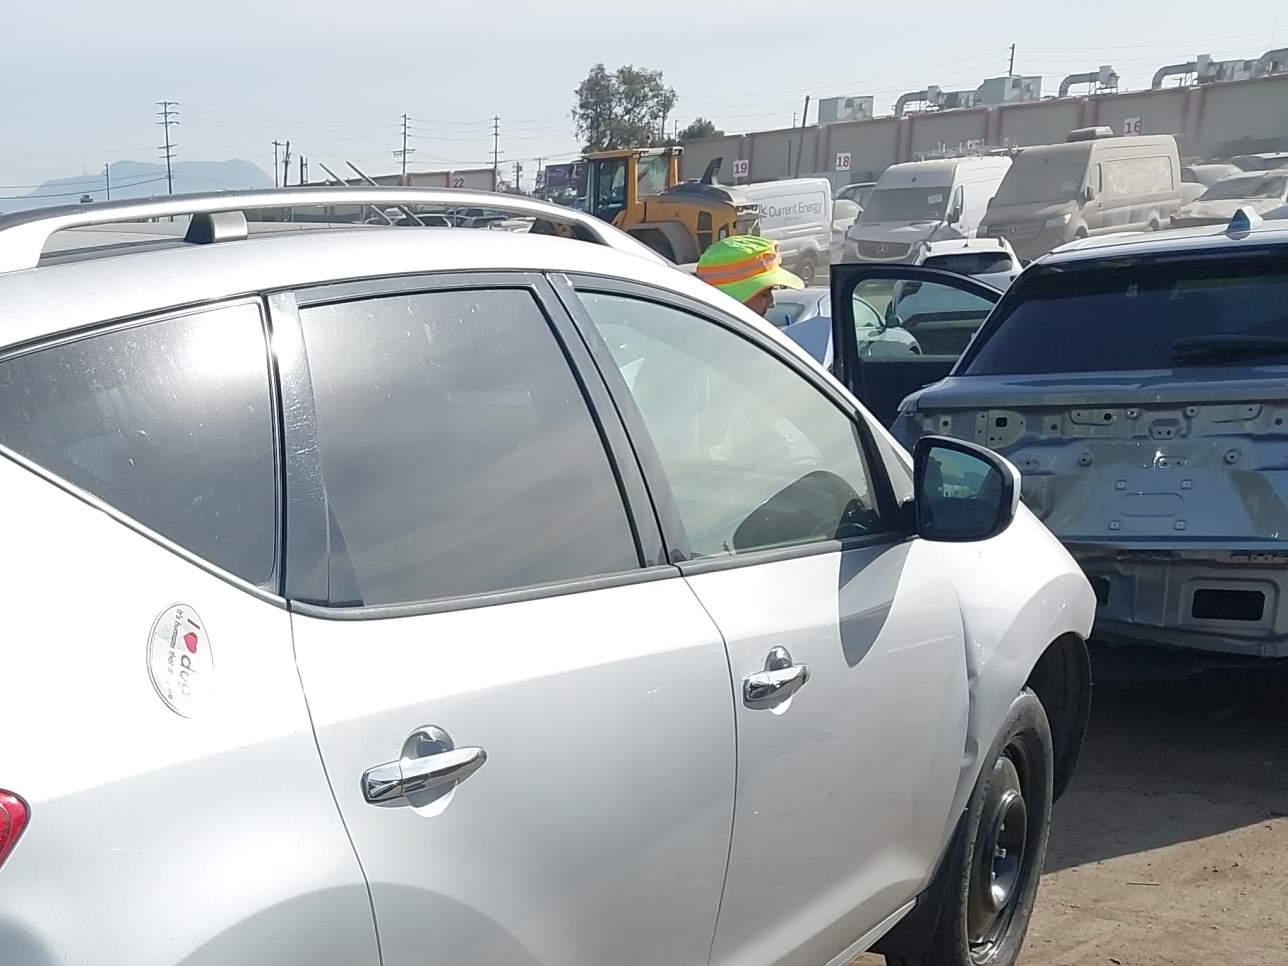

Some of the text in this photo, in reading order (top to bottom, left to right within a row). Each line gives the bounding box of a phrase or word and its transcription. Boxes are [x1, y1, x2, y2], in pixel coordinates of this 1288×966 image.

[1124, 121, 1142, 134] 16
[837, 155, 850, 168] 18
[735, 163, 748, 176] 19
[768, 202, 823, 218] Current Energy
